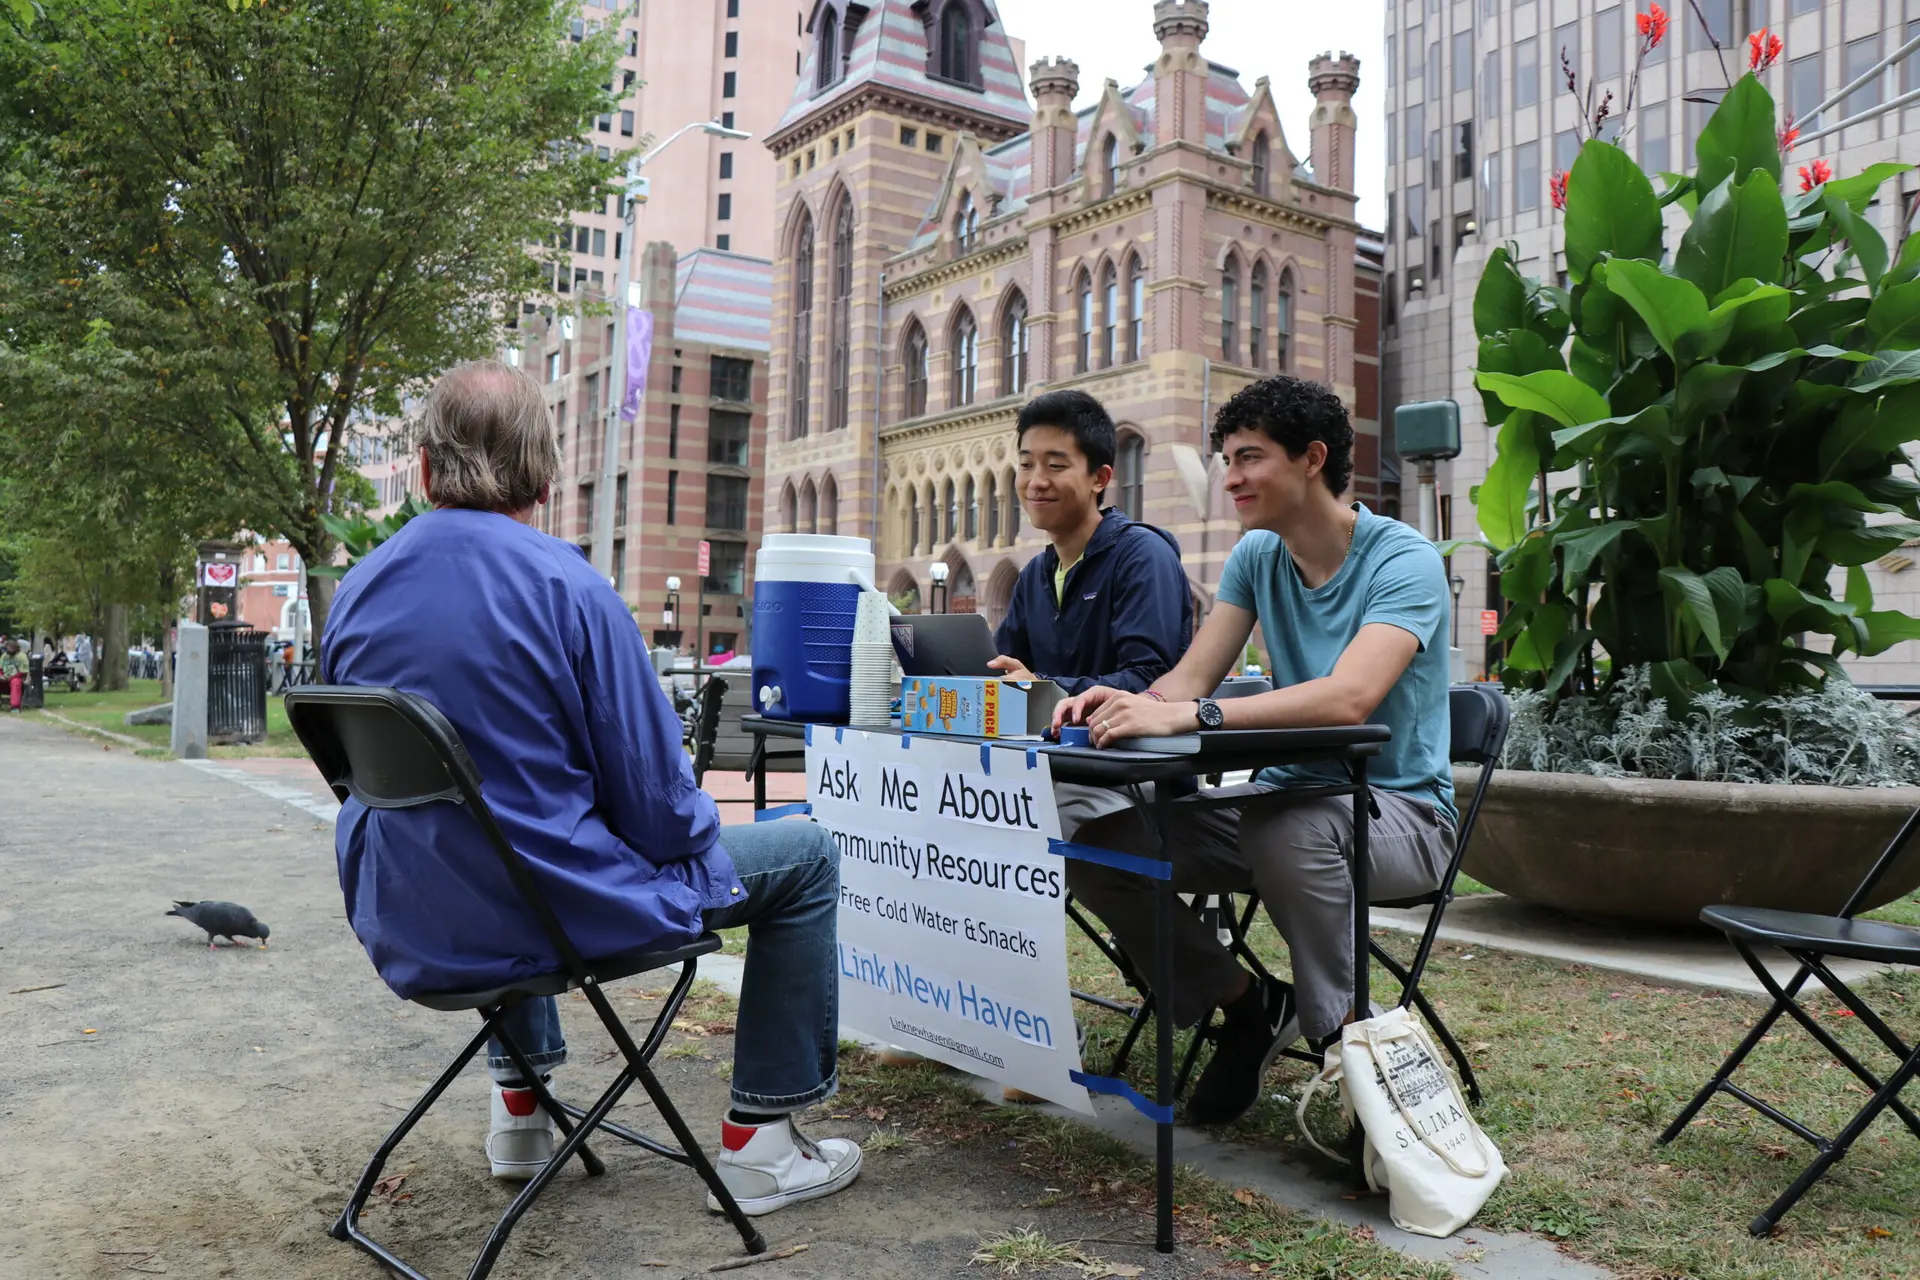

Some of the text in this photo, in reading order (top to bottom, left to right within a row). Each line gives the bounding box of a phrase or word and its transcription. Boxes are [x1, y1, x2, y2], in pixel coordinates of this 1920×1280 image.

[985, 683, 995, 734] 12 PACK
[818, 757, 1039, 829] Ask Me About
[811, 818, 1060, 899] mmunity Resources
[841, 885, 871, 913] Free
[876, 896, 908, 924] Cold
[912, 902, 958, 935] Water
[838, 942, 1052, 1047] Link New Haven
[1444, 1132, 1467, 1151] 1940
